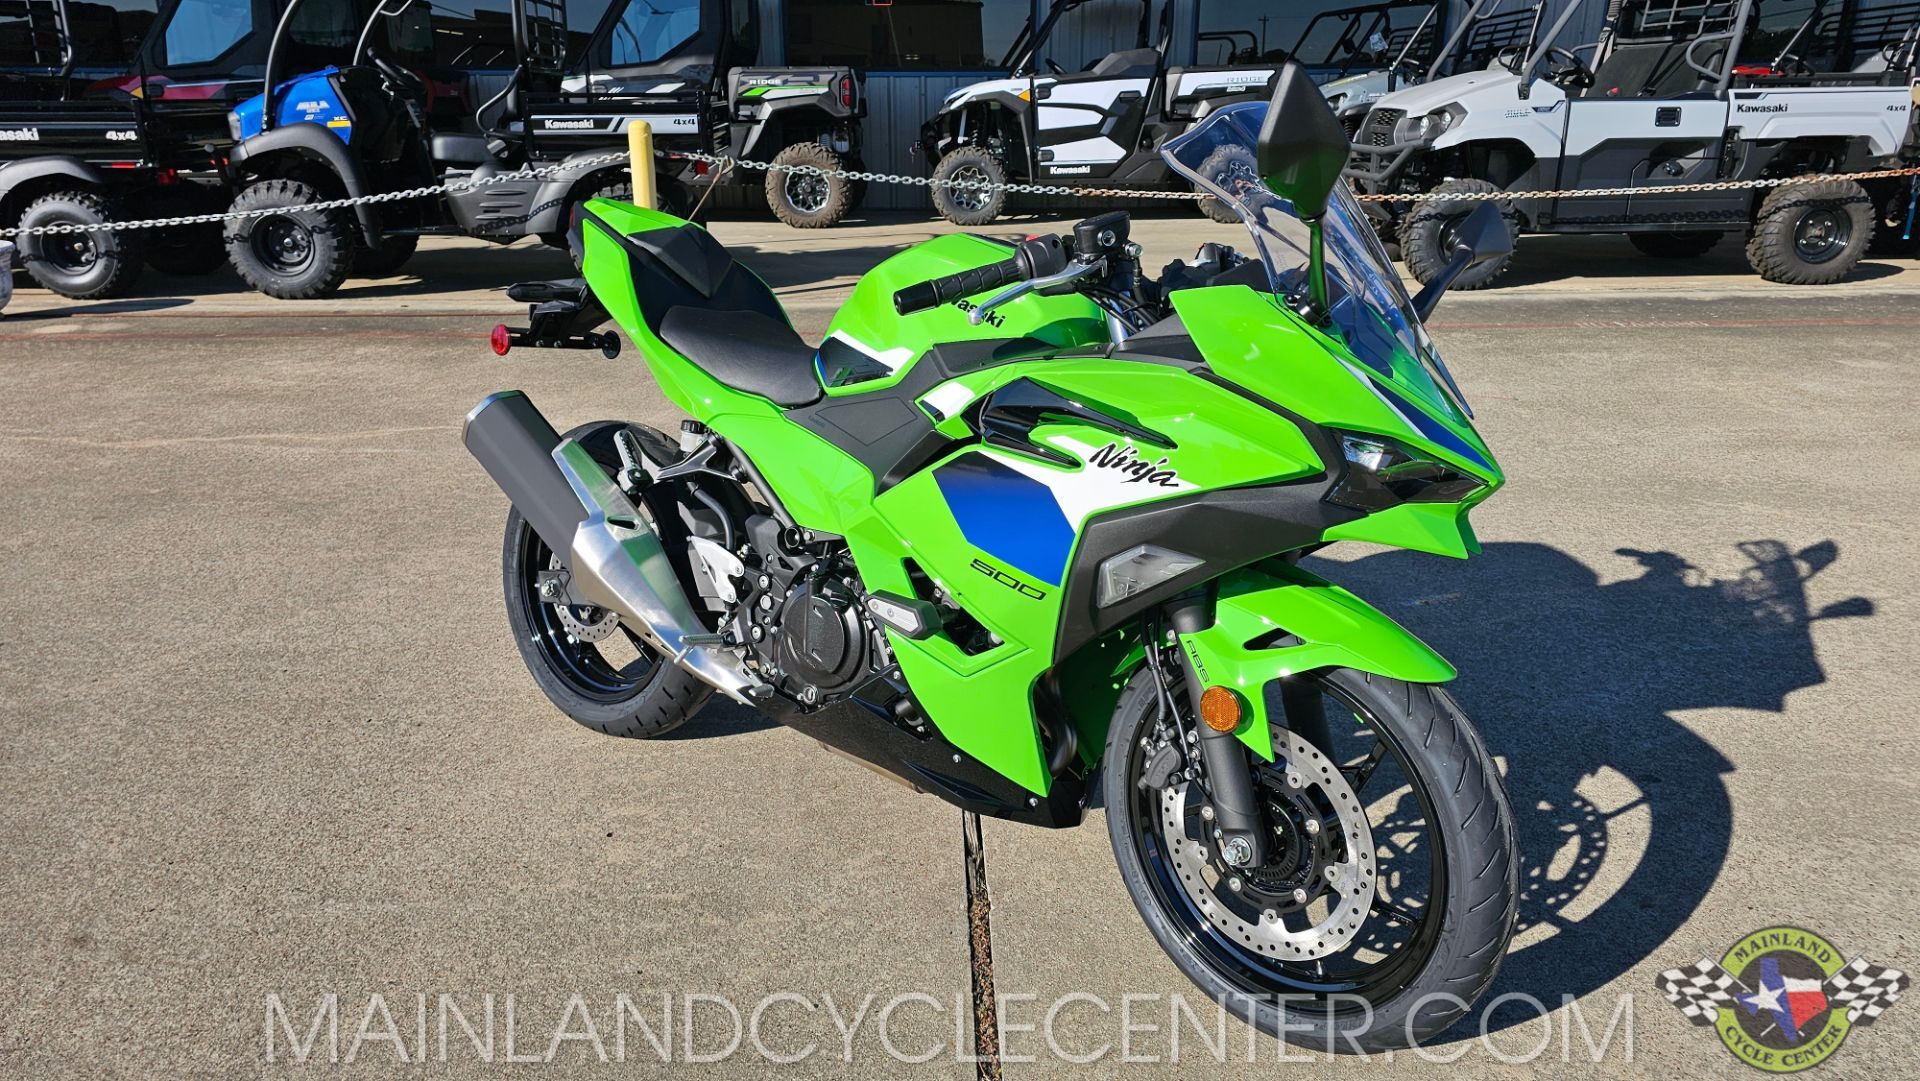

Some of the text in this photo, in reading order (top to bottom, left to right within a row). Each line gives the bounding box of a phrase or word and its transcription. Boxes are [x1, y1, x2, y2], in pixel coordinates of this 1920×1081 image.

[1736, 103, 1906, 113] Kawasaki 4x4
[544, 118, 696, 129] Kawasaki 4x4
[105, 130, 138, 141] 4x4
[1049, 165, 1091, 174] Kawasaki
[1088, 442, 1180, 488] Ninja
[969, 557, 1047, 602] 500
[1185, 639, 1211, 684] ABS
